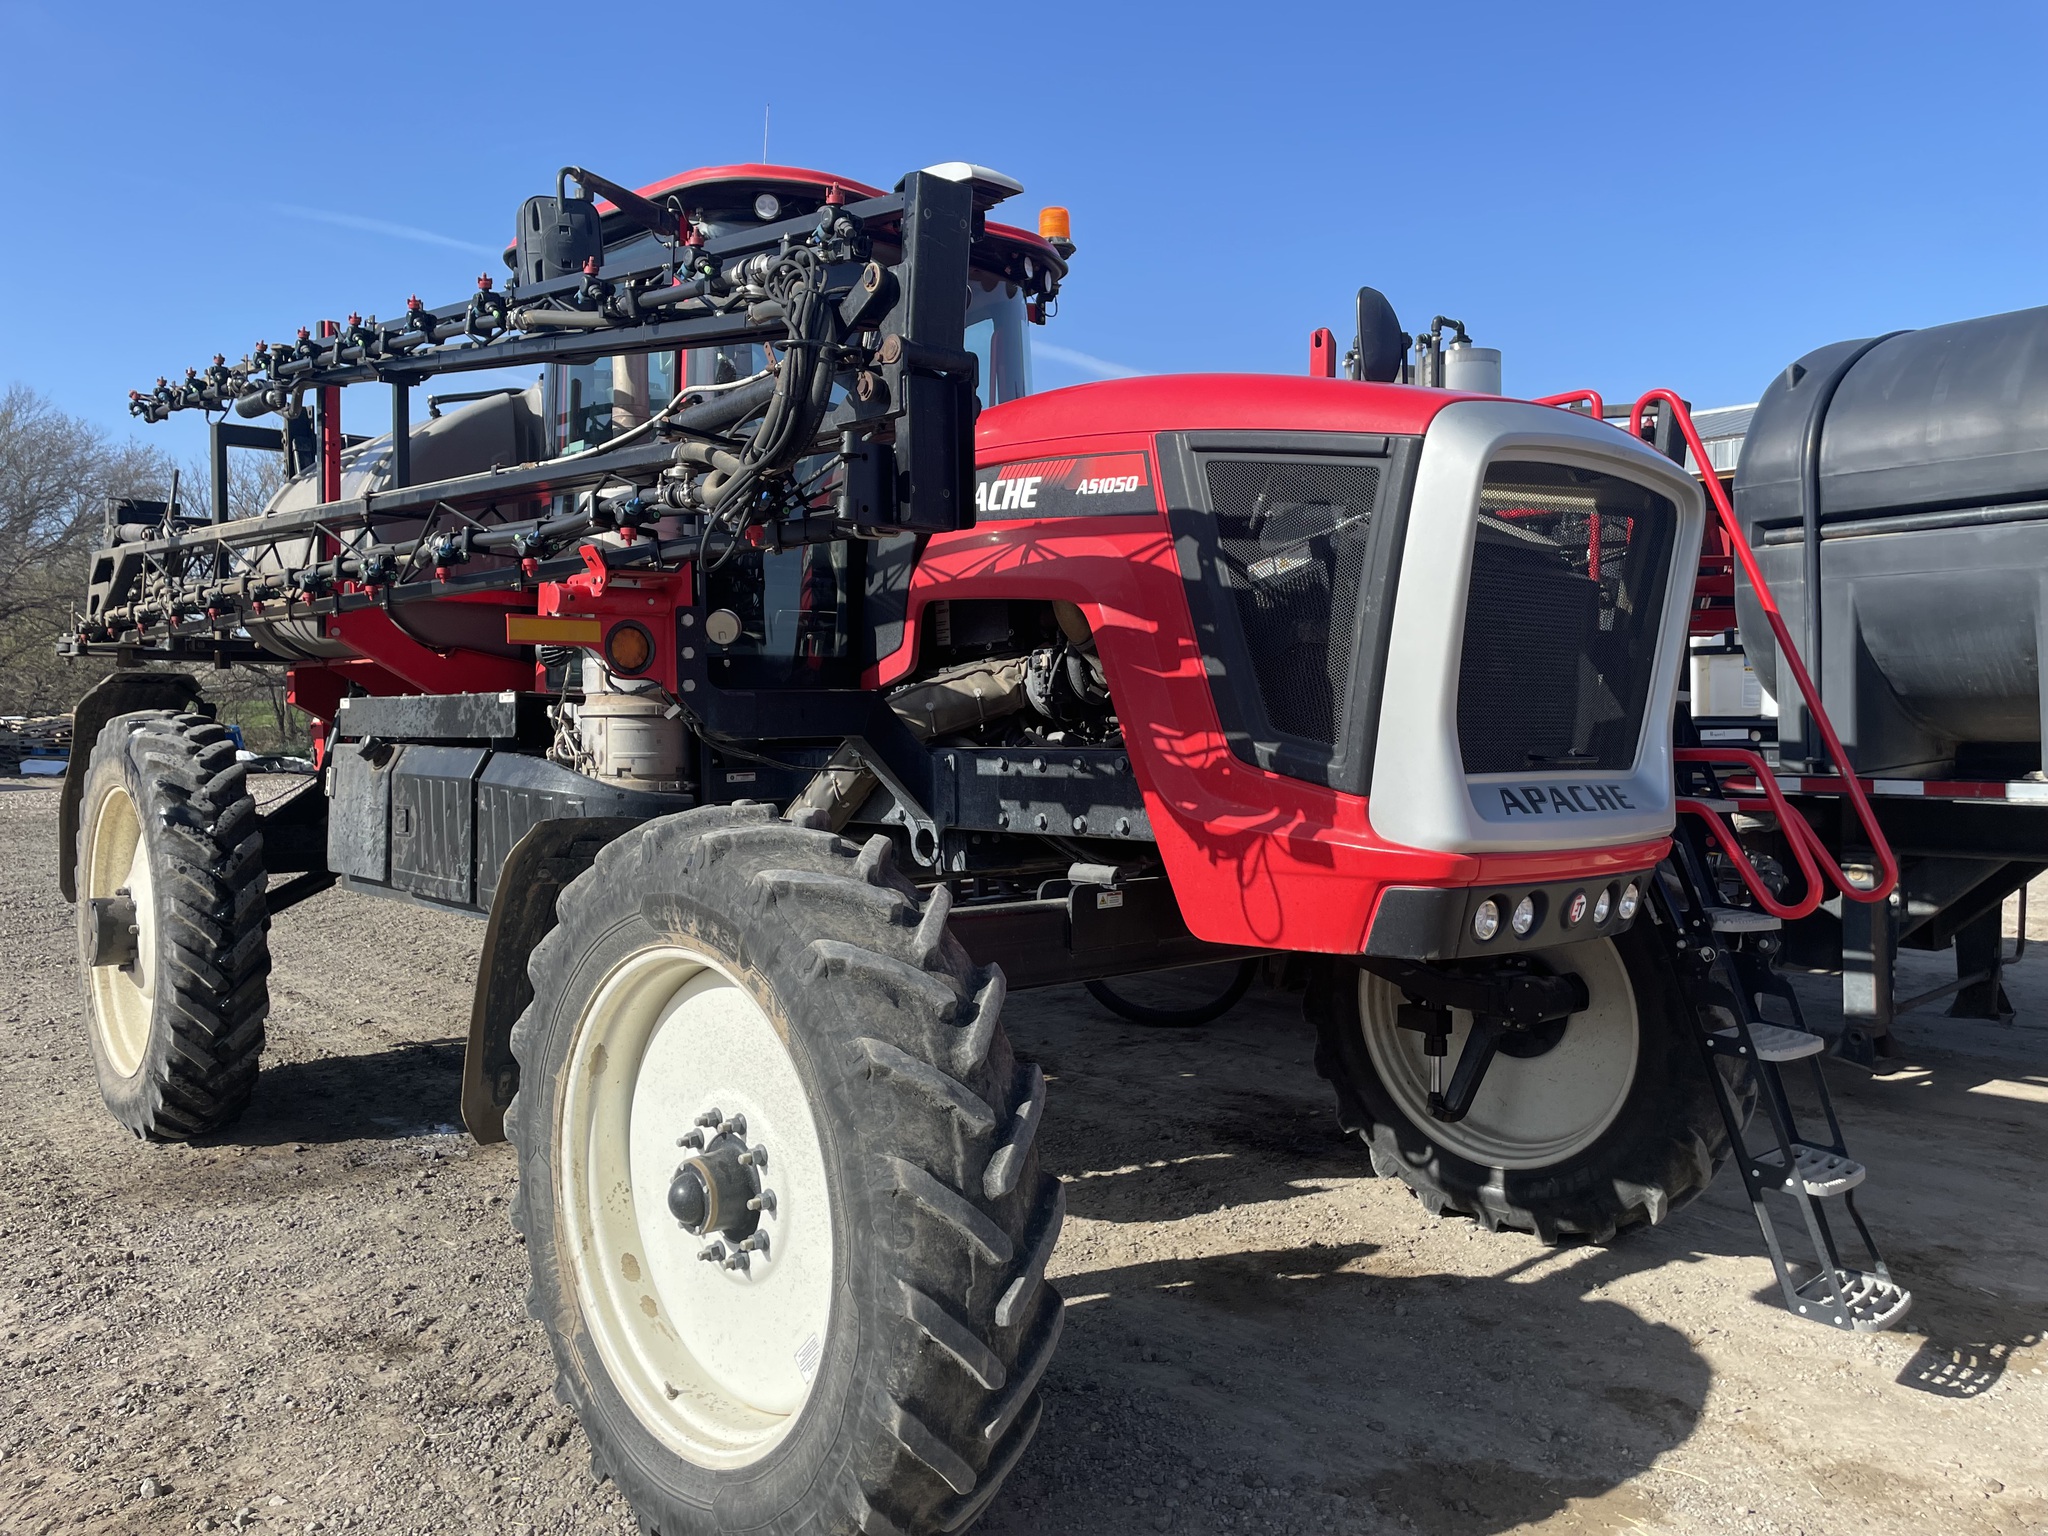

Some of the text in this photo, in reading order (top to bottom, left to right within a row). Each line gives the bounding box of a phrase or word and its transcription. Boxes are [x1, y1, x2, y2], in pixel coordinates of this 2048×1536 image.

[975, 475, 1139, 512] ACHE AS1050
[1498, 784, 1637, 816] APACHE
